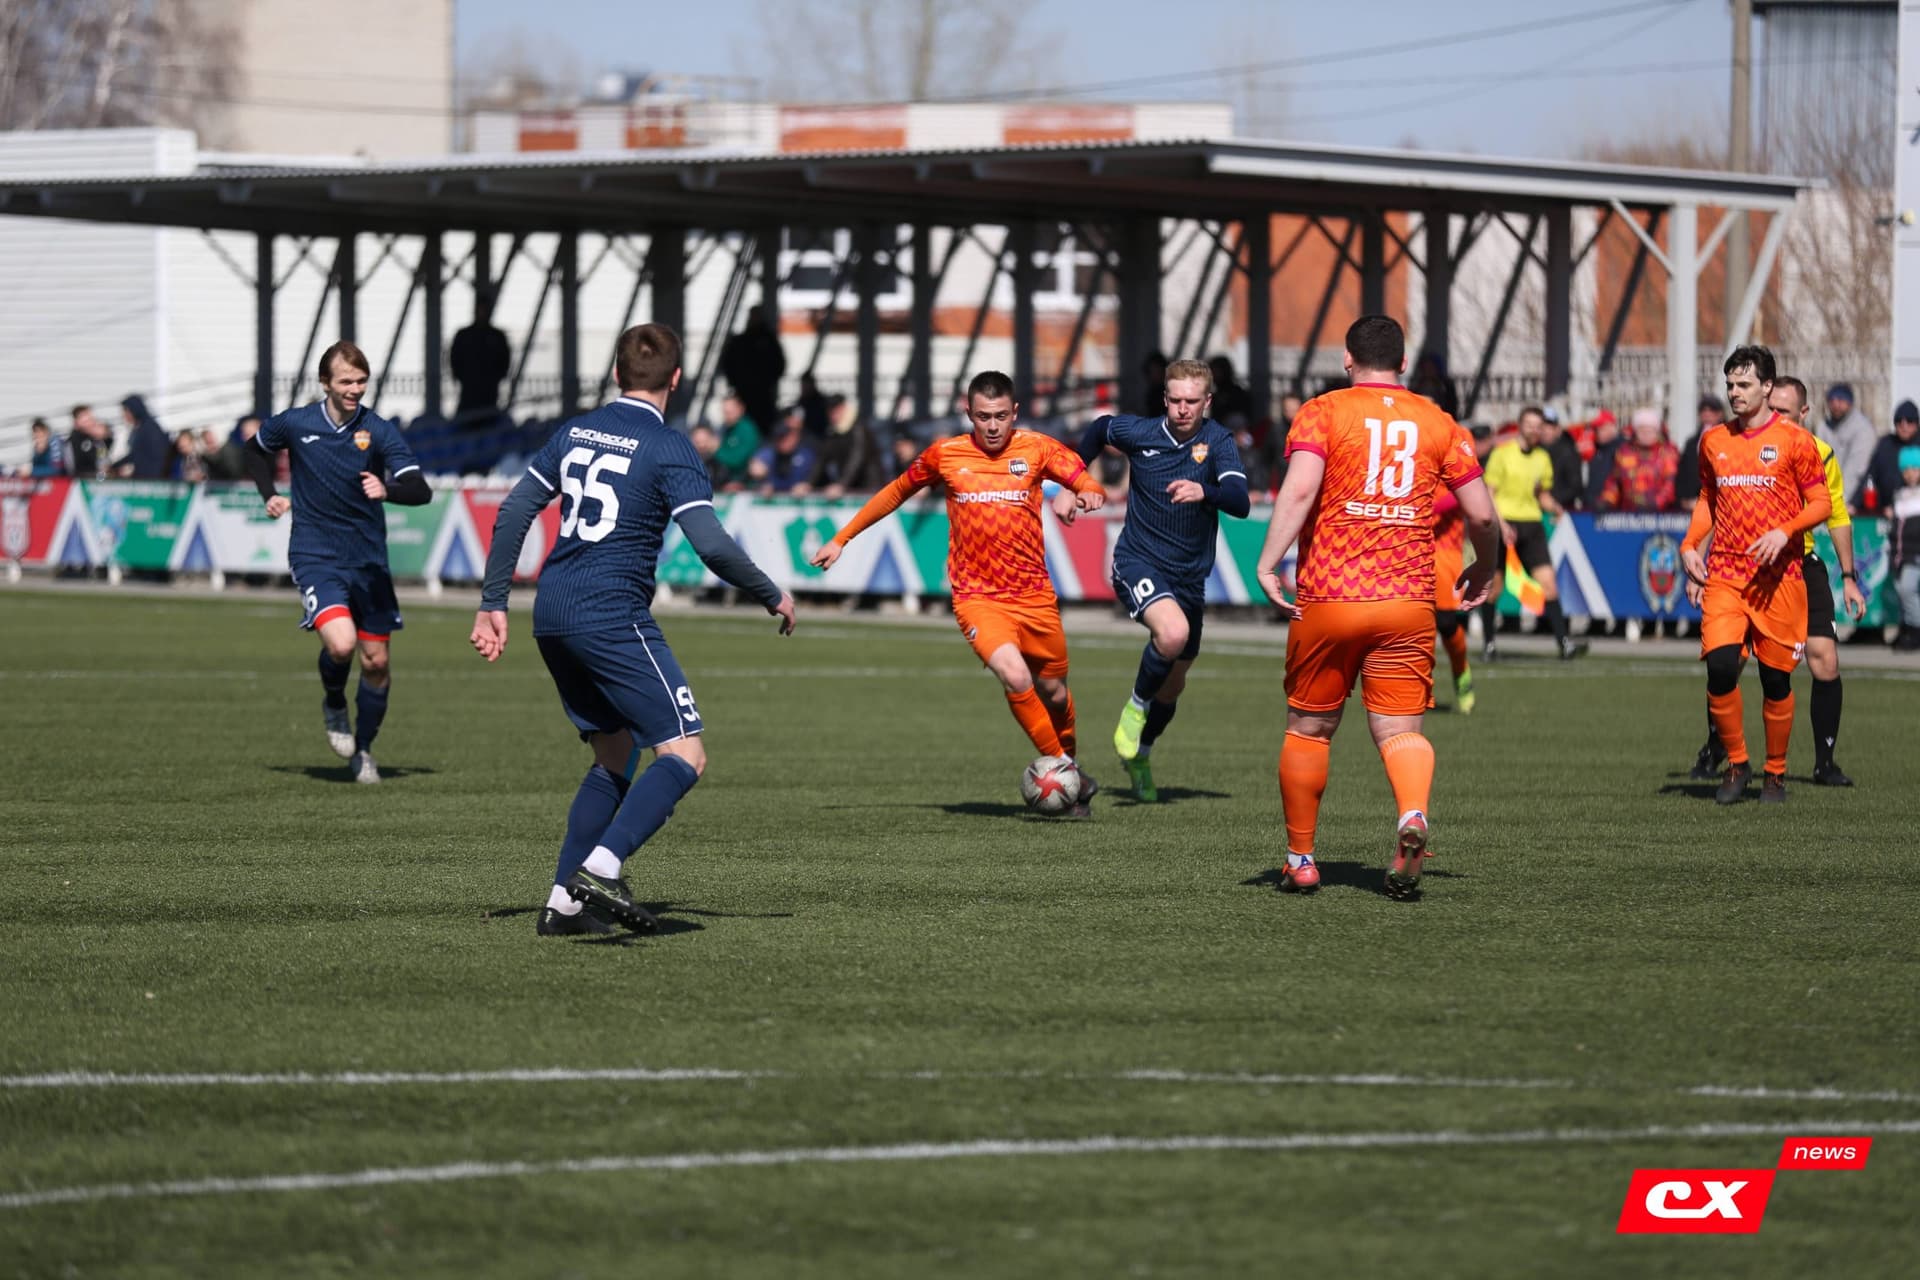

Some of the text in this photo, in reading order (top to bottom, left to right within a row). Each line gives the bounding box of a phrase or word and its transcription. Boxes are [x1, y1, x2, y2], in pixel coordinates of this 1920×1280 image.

[1364, 418, 1418, 498] 13
[559, 446, 632, 543] 55
[1345, 501, 1416, 520] SEUS
[1133, 577, 1156, 605] 10
